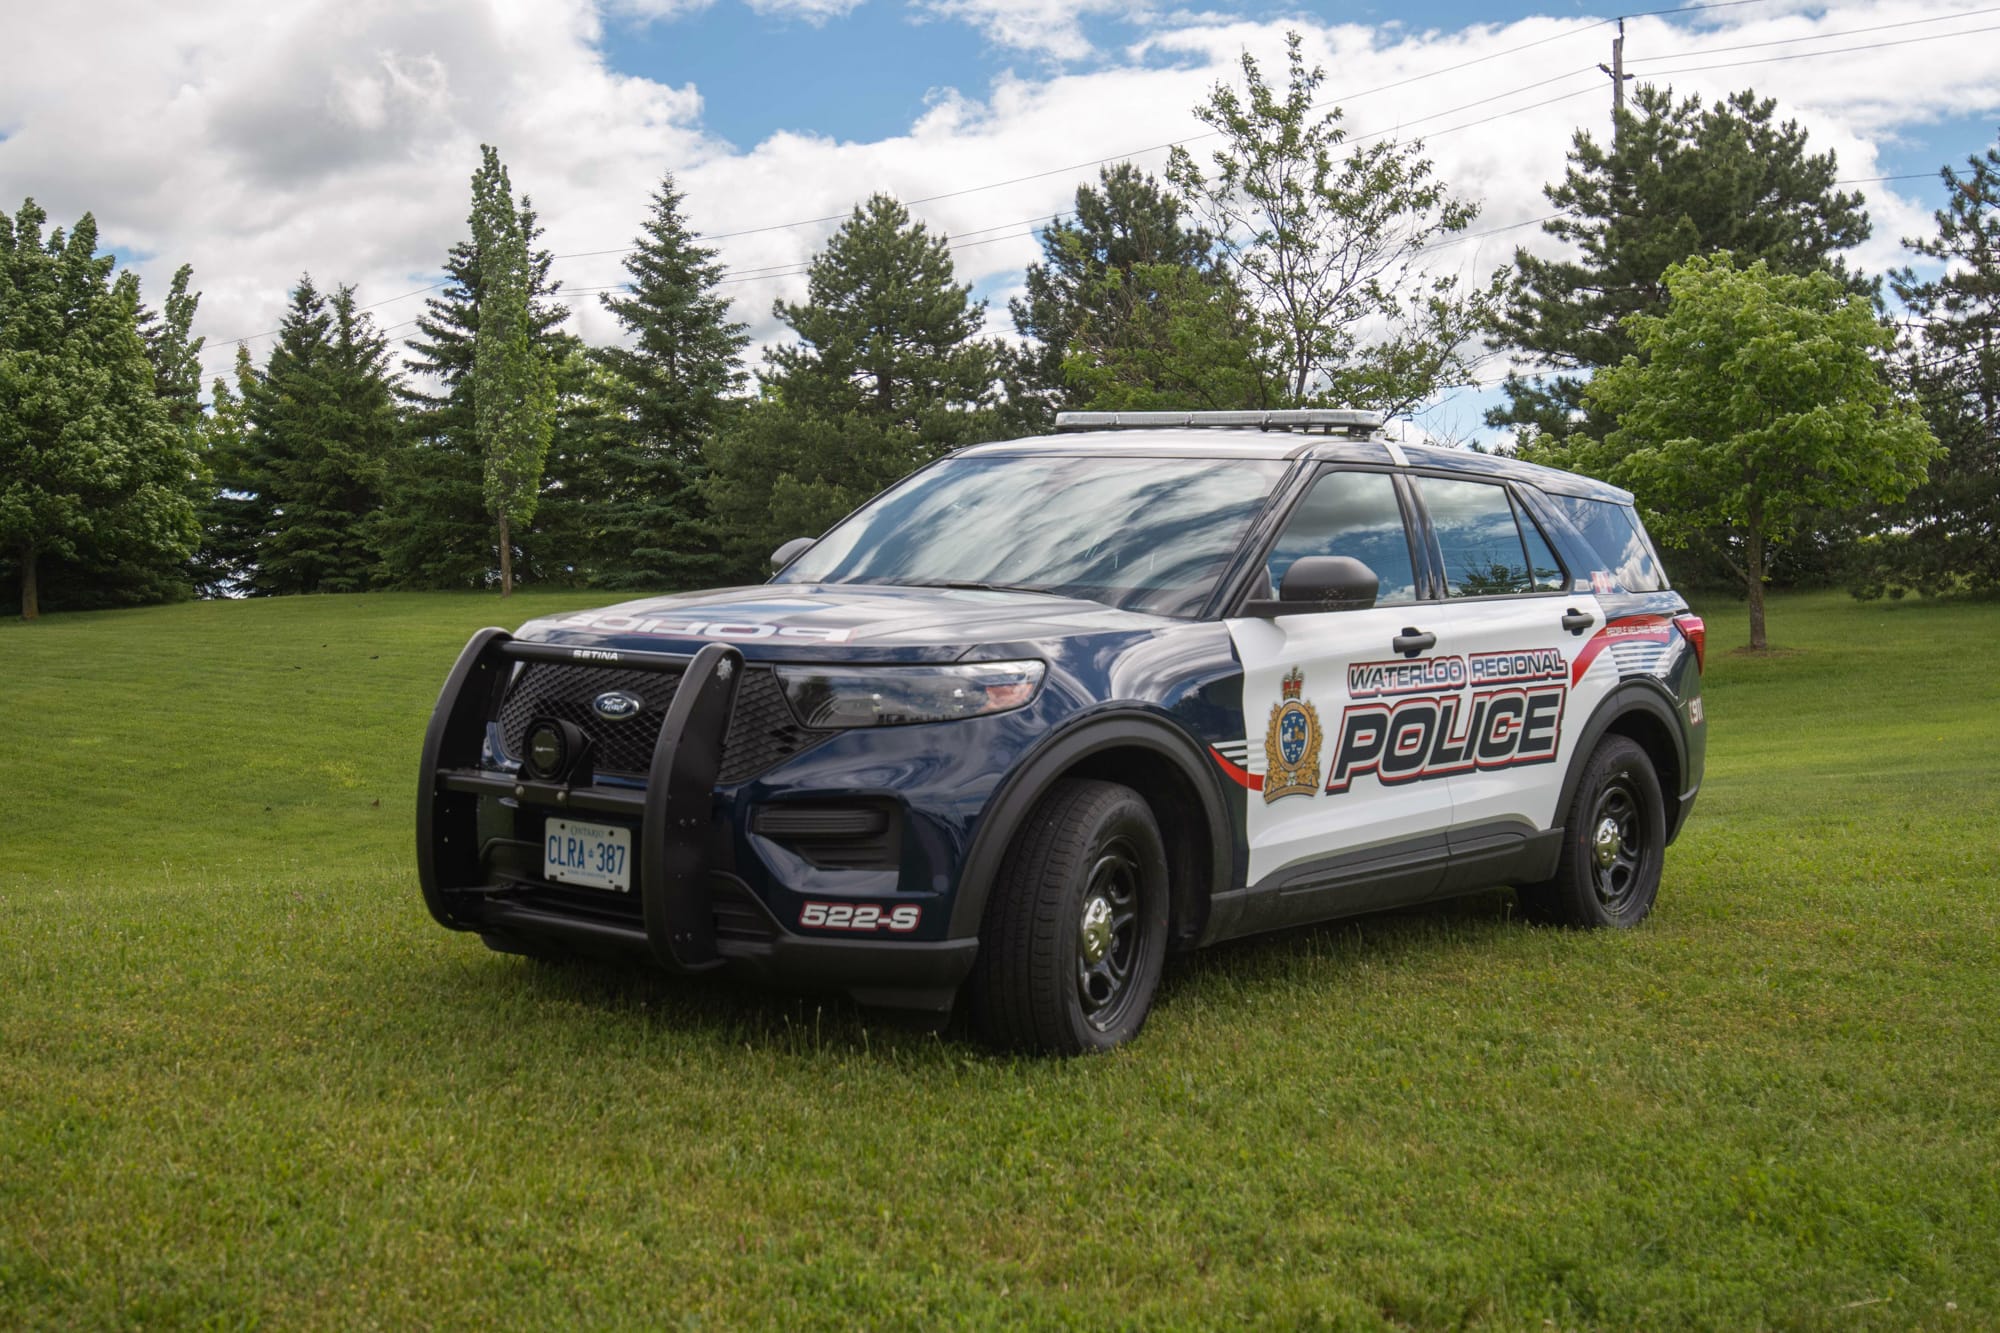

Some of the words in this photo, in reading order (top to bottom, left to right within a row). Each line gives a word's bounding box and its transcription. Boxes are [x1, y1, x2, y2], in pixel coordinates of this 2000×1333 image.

[573, 649, 619, 661] SETINA
[1349, 658, 1465, 696] WATERLOO
[1470, 650, 1567, 684] REGIONAL
[1328, 689, 1564, 789] POLICE
[548, 835, 585, 869] CLRA
[596, 842, 625, 876] 387
[799, 902, 921, 931] 522-S
